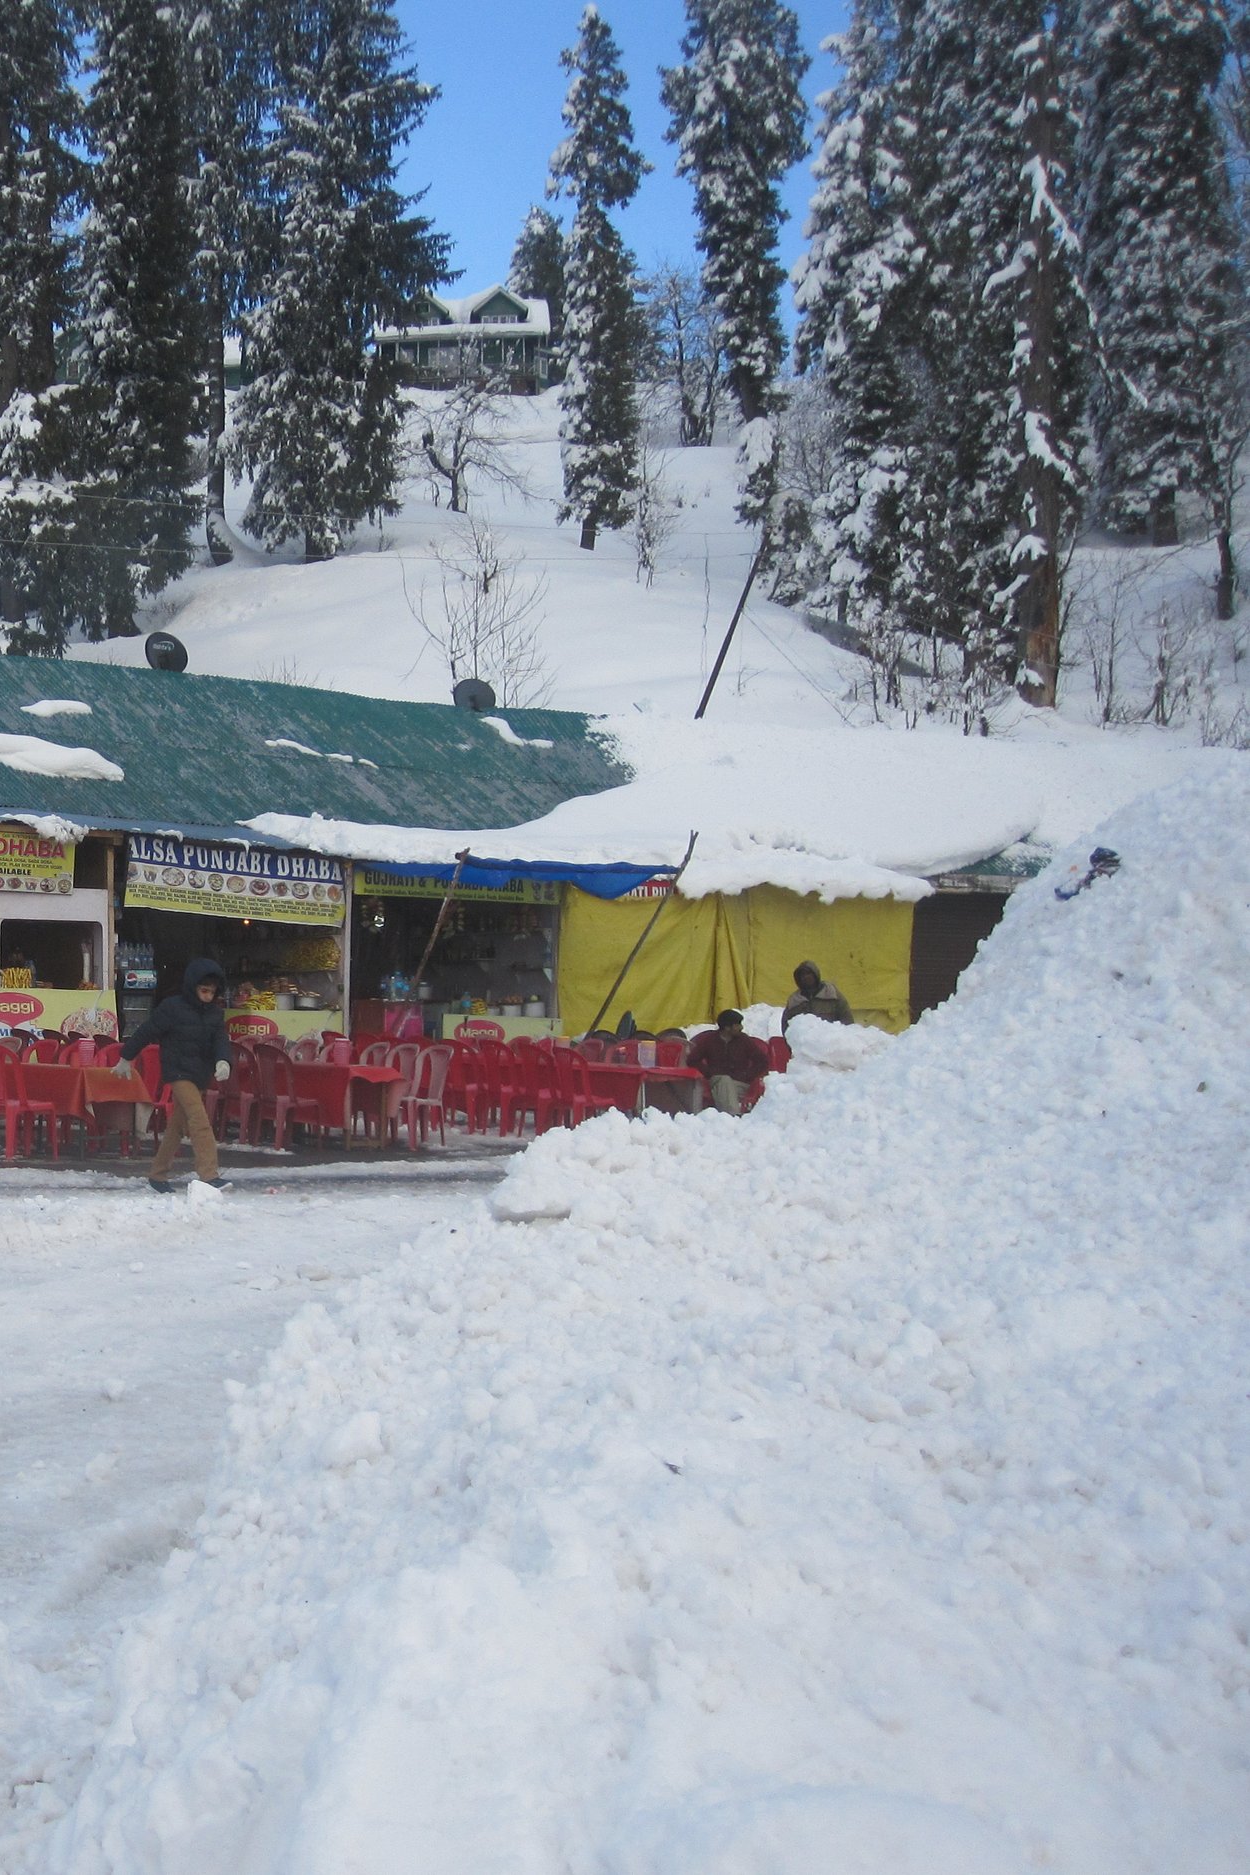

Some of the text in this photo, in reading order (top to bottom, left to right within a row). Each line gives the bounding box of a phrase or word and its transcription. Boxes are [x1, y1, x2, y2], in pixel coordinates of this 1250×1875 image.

[183, 844, 271, 875] PUNJABI
[277, 855, 343, 881] DHABA
[229, 1023, 270, 1036] Maggi
